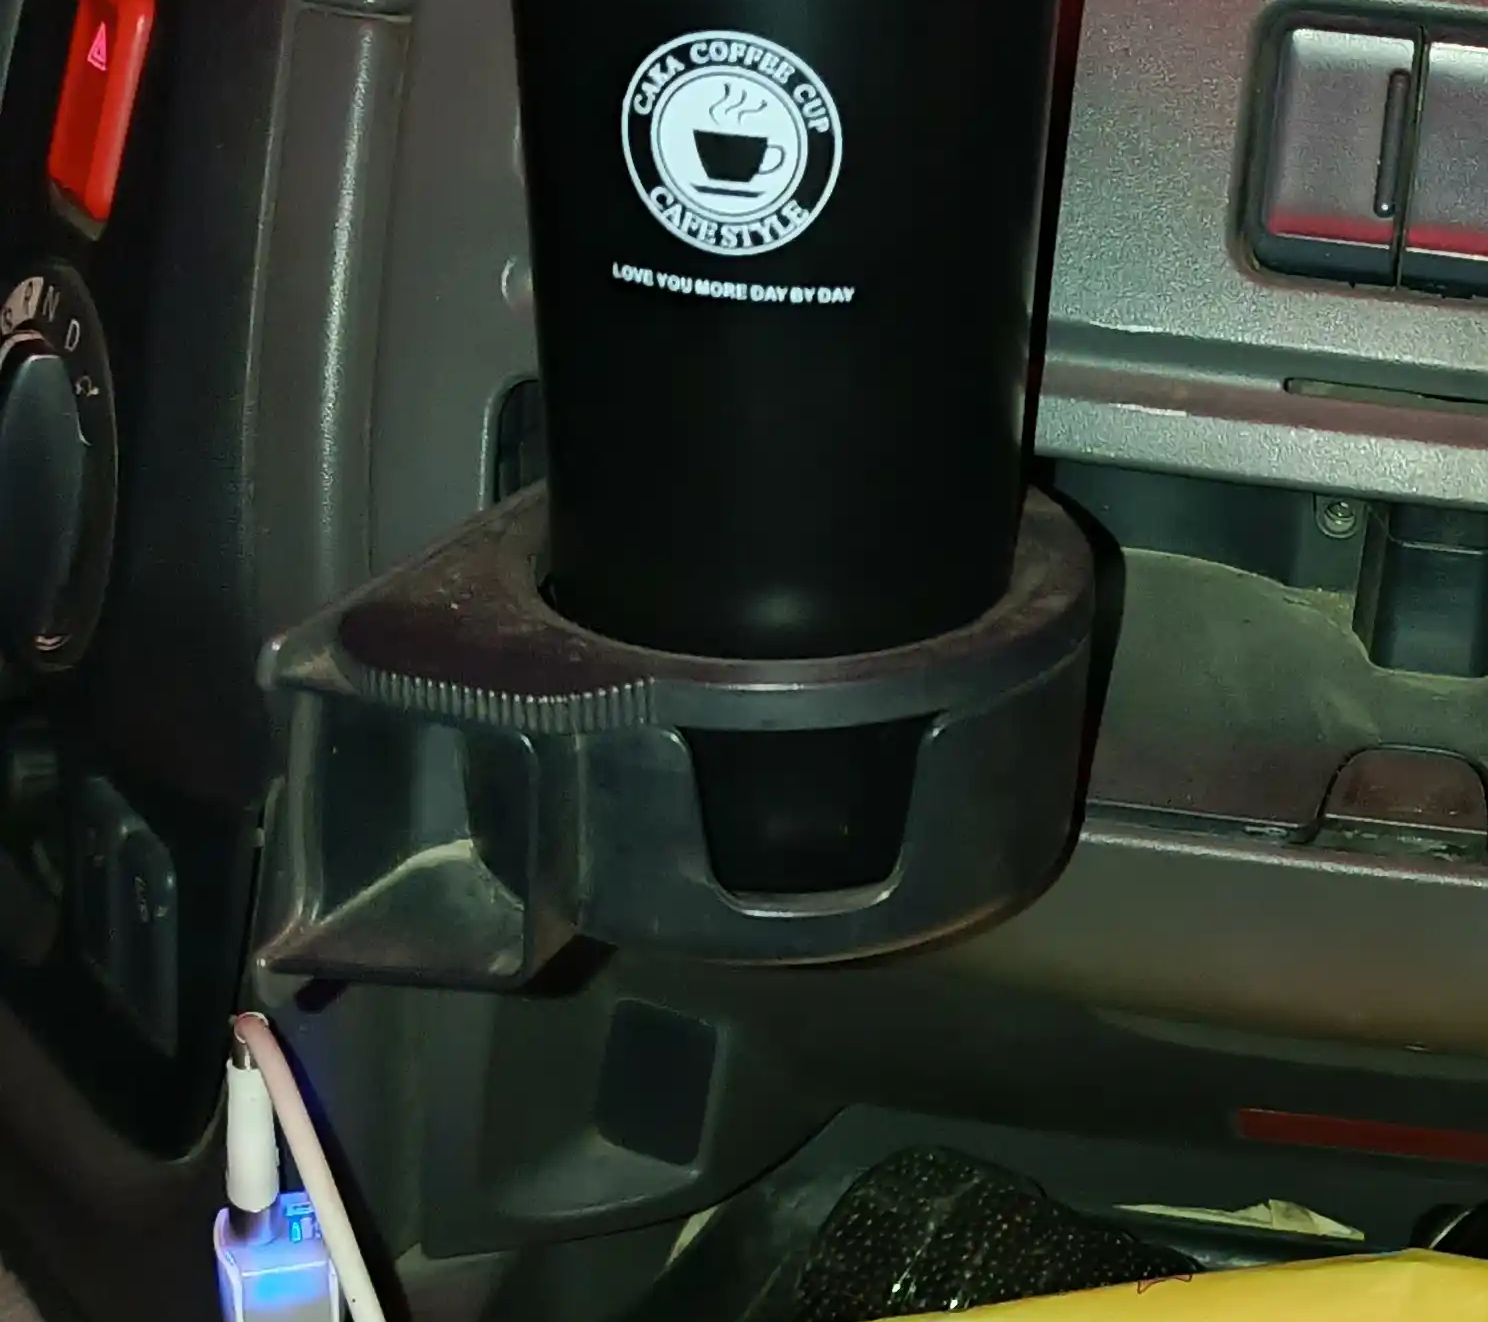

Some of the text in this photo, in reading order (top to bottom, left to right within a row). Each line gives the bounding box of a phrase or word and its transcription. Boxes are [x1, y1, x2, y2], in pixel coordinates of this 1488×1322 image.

[633, 41, 831, 134] CAKA COFFEE CUP
[612, 262, 855, 304] LOVE YOU MORE DAY BY DAY
[64, 318, 81, 352] D
